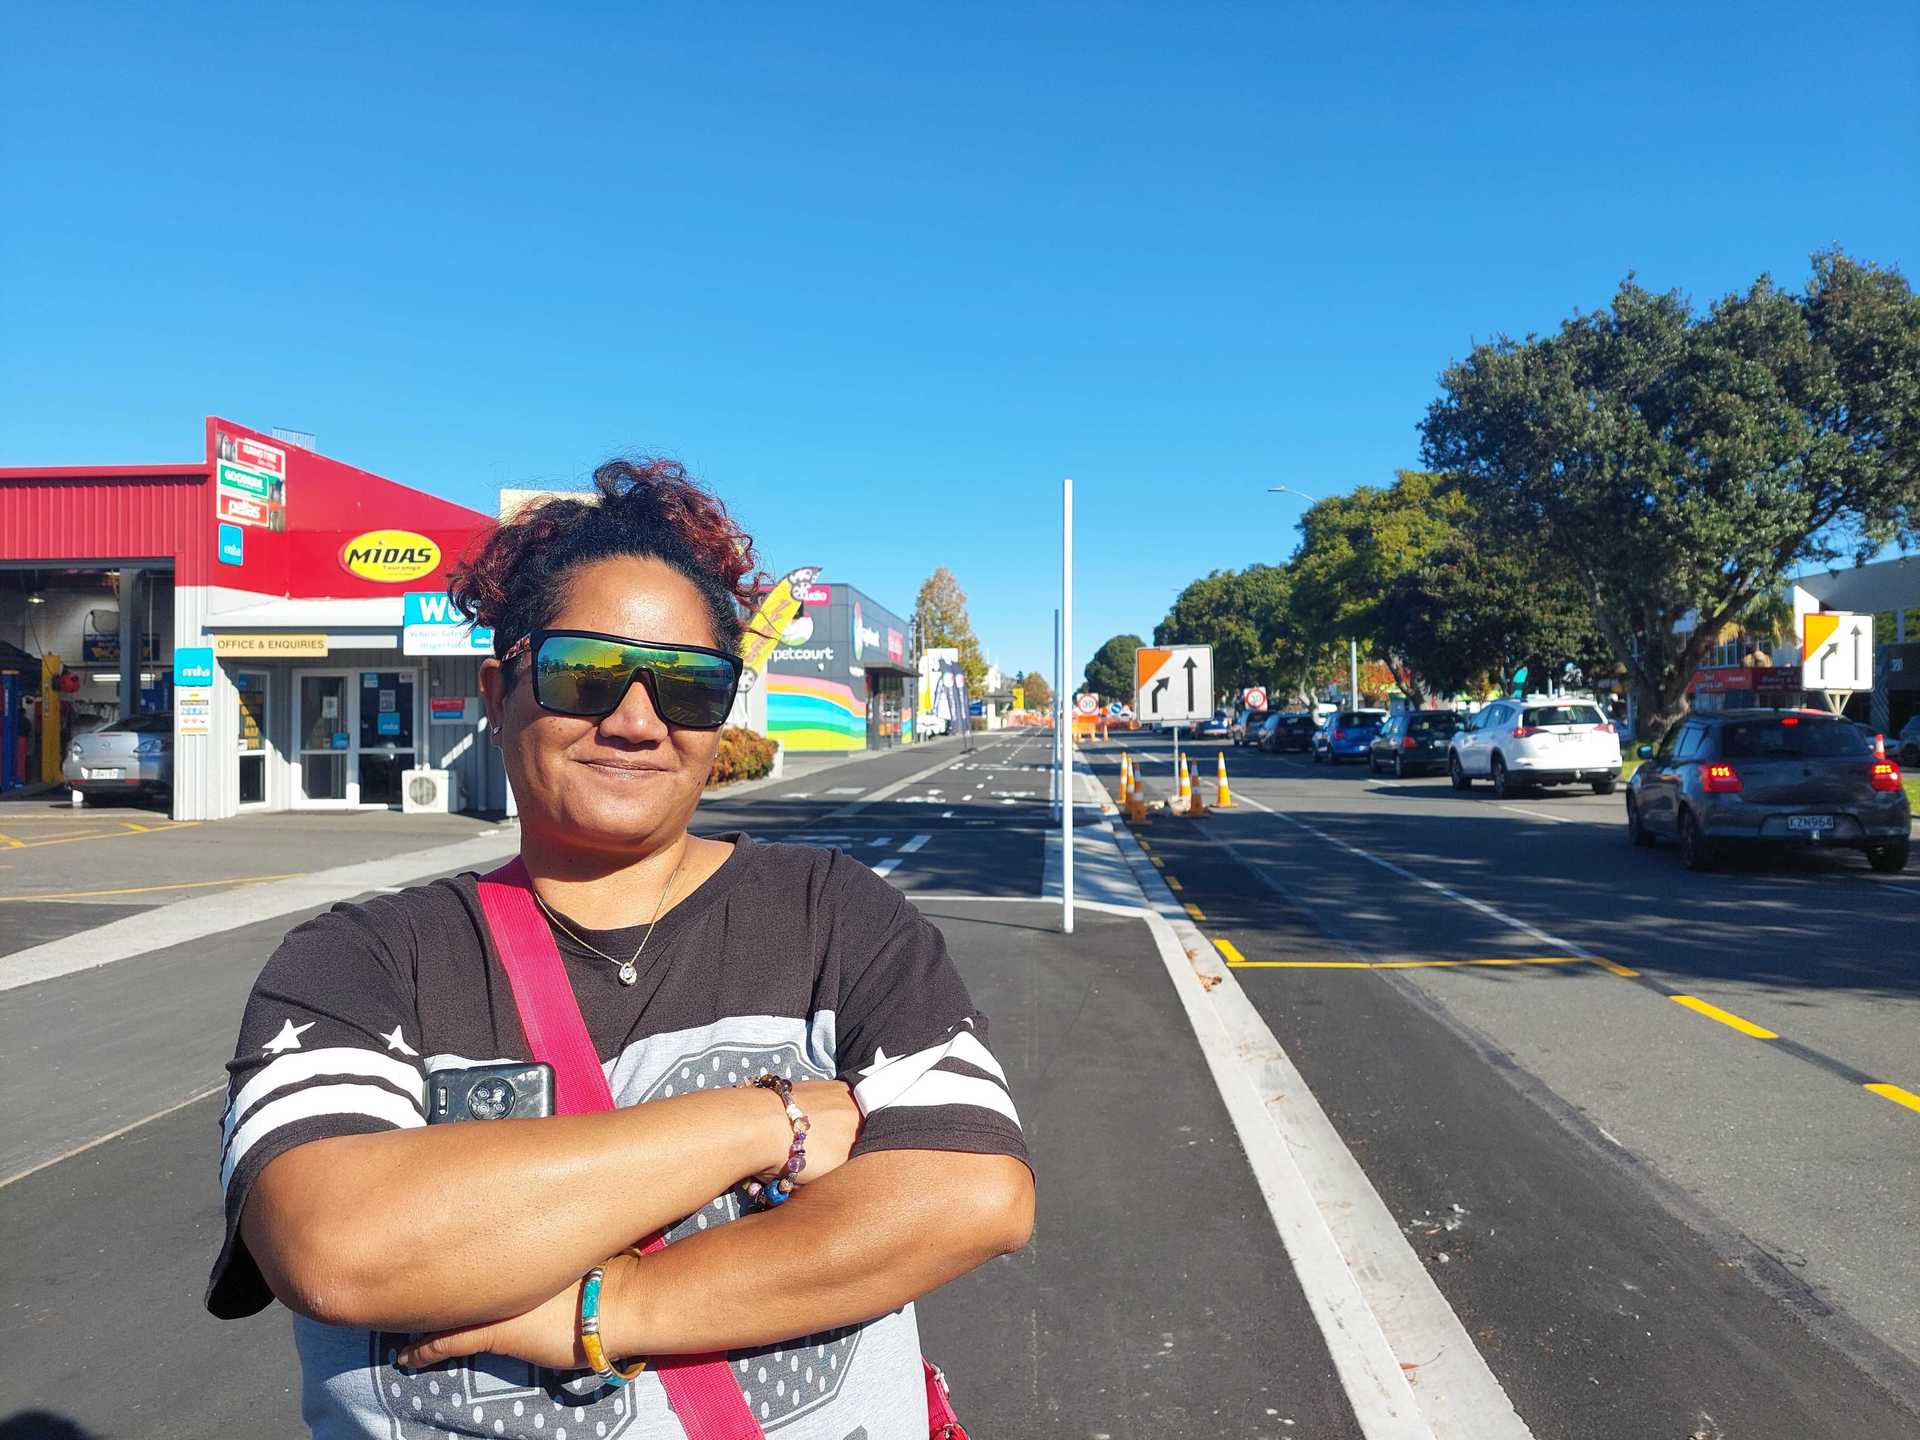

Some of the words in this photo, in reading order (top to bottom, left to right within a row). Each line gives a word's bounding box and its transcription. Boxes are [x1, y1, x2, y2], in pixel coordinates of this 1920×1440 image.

[348, 547, 432, 565] MIDAS
[217, 639, 255, 649] OFFICE
[258, 639, 265, 649] &
[268, 639, 325, 649] ENQUIRIES
[768, 647, 834, 663] rpetcourt
[182, 665, 211, 678] mta
[1083, 699, 1094, 709] 30
